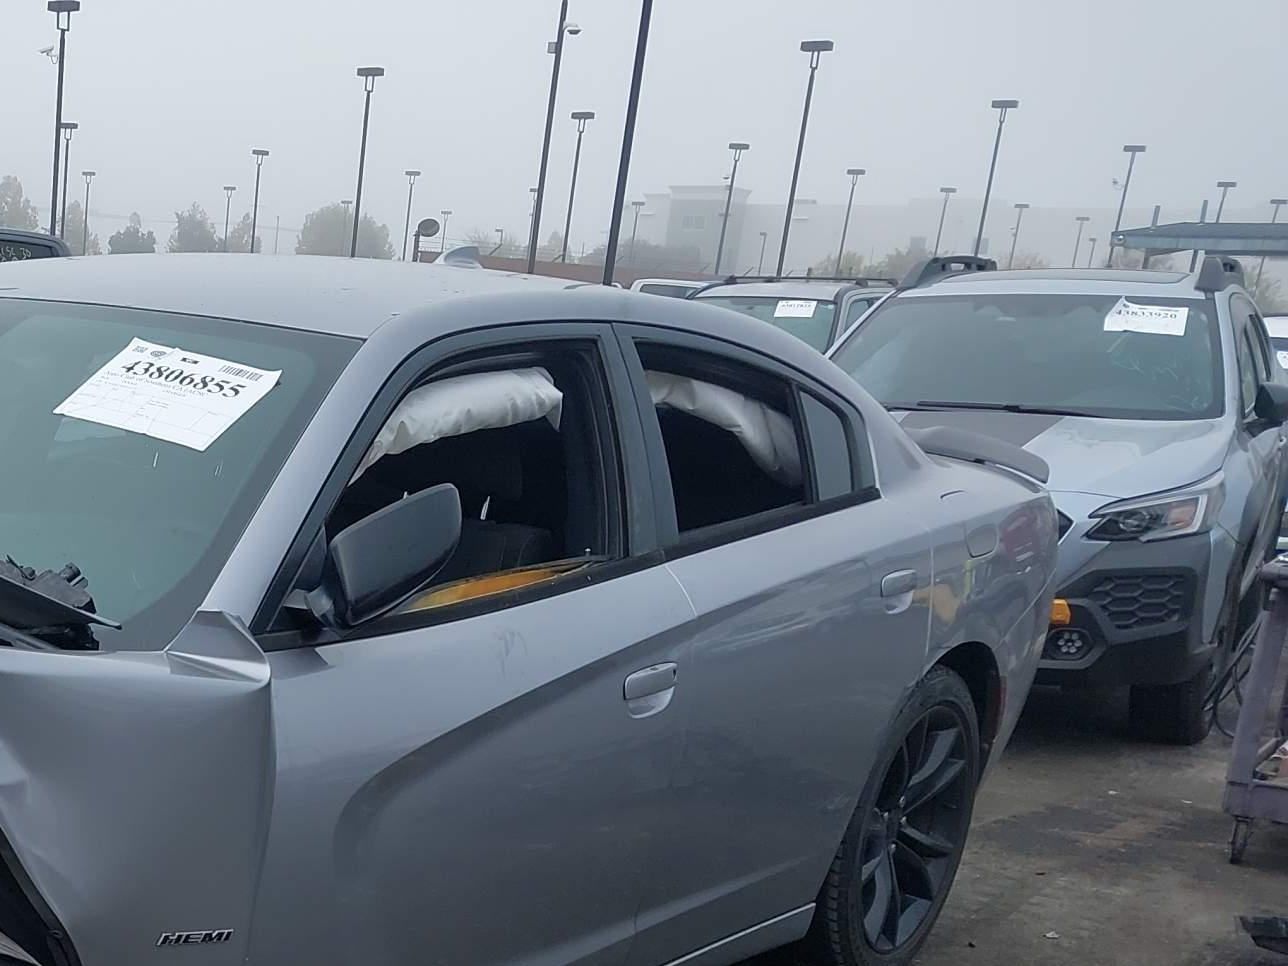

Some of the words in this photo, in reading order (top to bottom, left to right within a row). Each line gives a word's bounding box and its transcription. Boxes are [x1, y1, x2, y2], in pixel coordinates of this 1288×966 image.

[1115, 309, 1178, 320] 43833920
[122, 360, 248, 399] 43806855
[156, 928, 234, 946] HEMI
